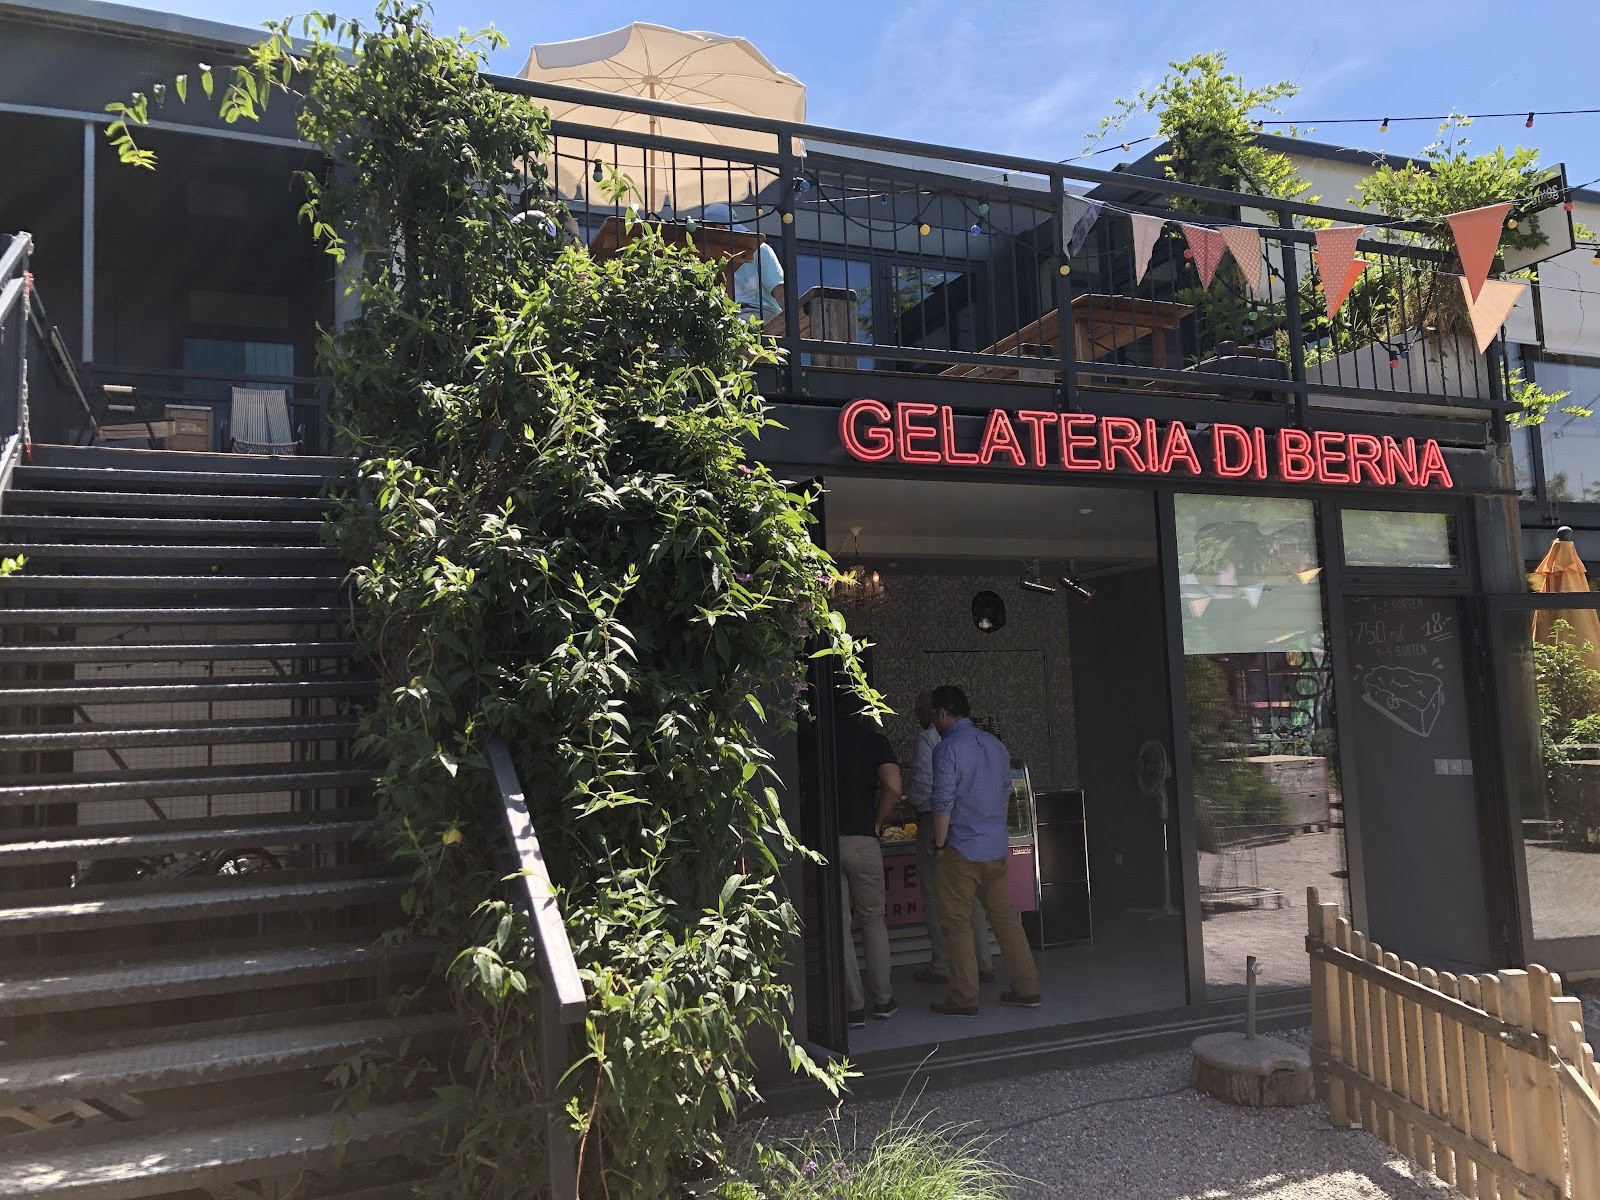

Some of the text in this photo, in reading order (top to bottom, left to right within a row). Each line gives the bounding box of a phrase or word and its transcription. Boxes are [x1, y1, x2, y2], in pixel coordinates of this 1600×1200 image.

[838, 399, 1454, 489] GELATERIA DI BERNA
[1391, 598, 1424, 612] SORTEN
[1354, 620, 1405, 646] 750 ml
[1396, 643, 1427, 657] SORTEN
